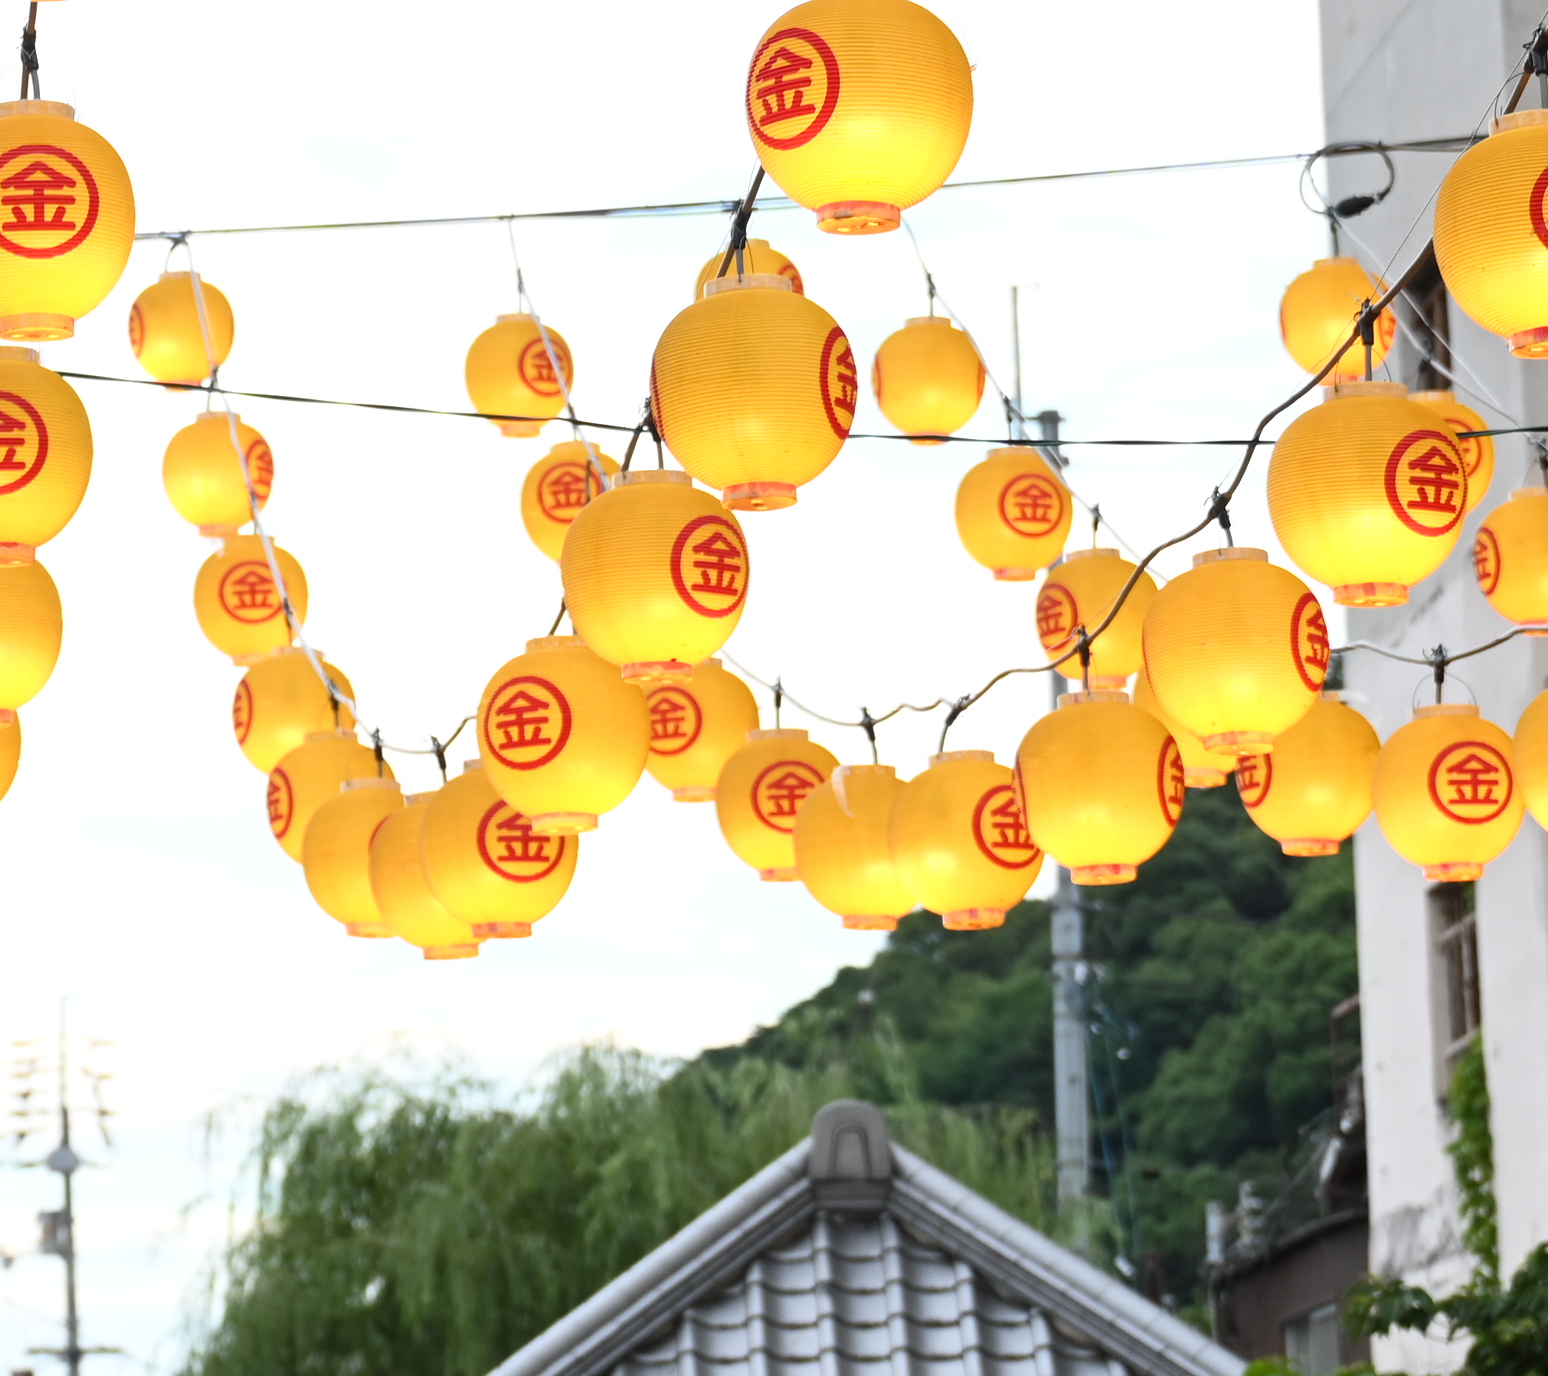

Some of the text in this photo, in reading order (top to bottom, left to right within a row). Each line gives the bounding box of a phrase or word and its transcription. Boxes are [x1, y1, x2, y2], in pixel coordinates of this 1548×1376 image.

[756, 47, 816, 126] 金
[1, 161, 77, 232] 金
[531, 350, 564, 382] 金
[549, 472, 590, 506] 金
[1014, 484, 1054, 523] 金
[1408, 447, 1460, 513] 金
[692, 532, 742, 596] 金
[231, 572, 277, 608] 金
[1037, 595, 1066, 638] 金
[496, 691, 552, 750] 金
[650, 697, 688, 741] 金
[1447, 753, 1500, 805] 金
